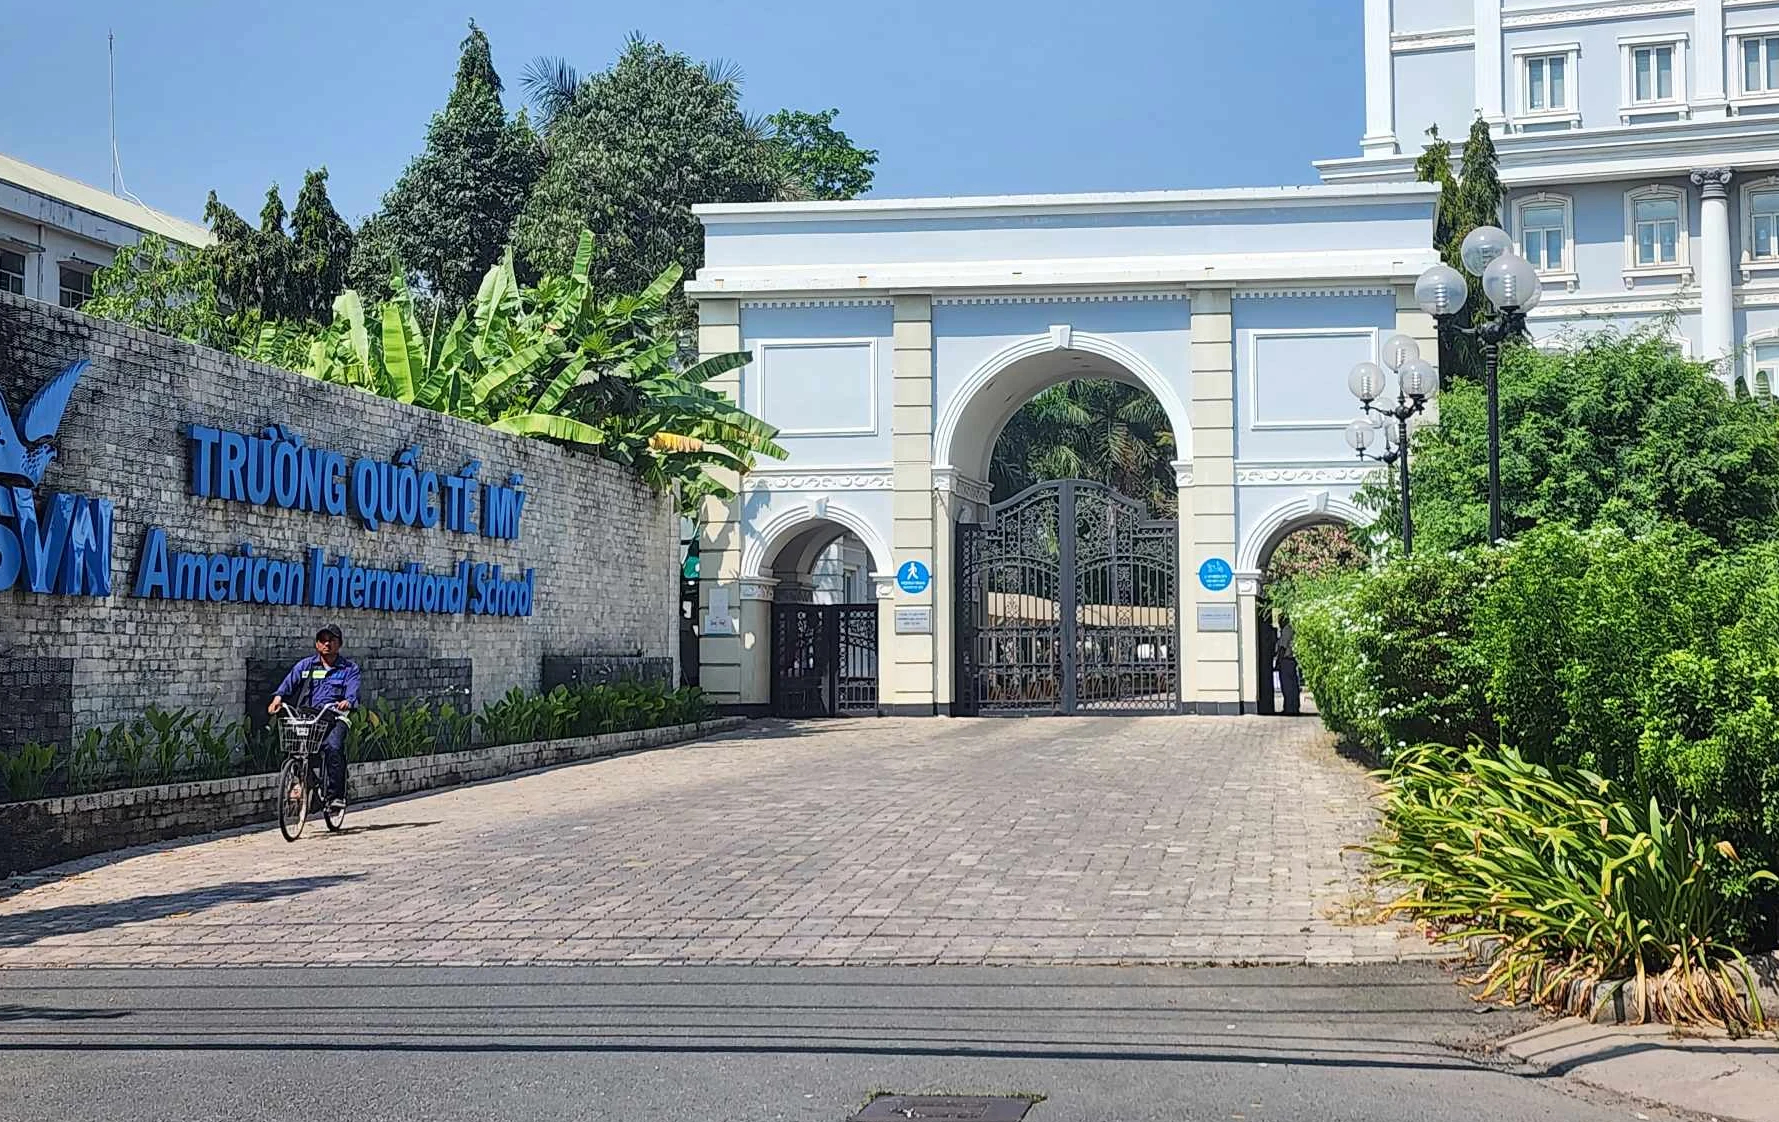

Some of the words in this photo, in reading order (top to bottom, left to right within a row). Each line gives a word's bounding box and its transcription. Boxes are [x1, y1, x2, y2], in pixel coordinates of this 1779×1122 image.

[190, 423, 347, 517] TRƯỜNG
[354, 443, 440, 531] QUỐC
[443, 458, 482, 534] TẾ
[135, 526, 305, 605] American
[312, 547, 470, 614] International
[472, 561, 534, 616] School
